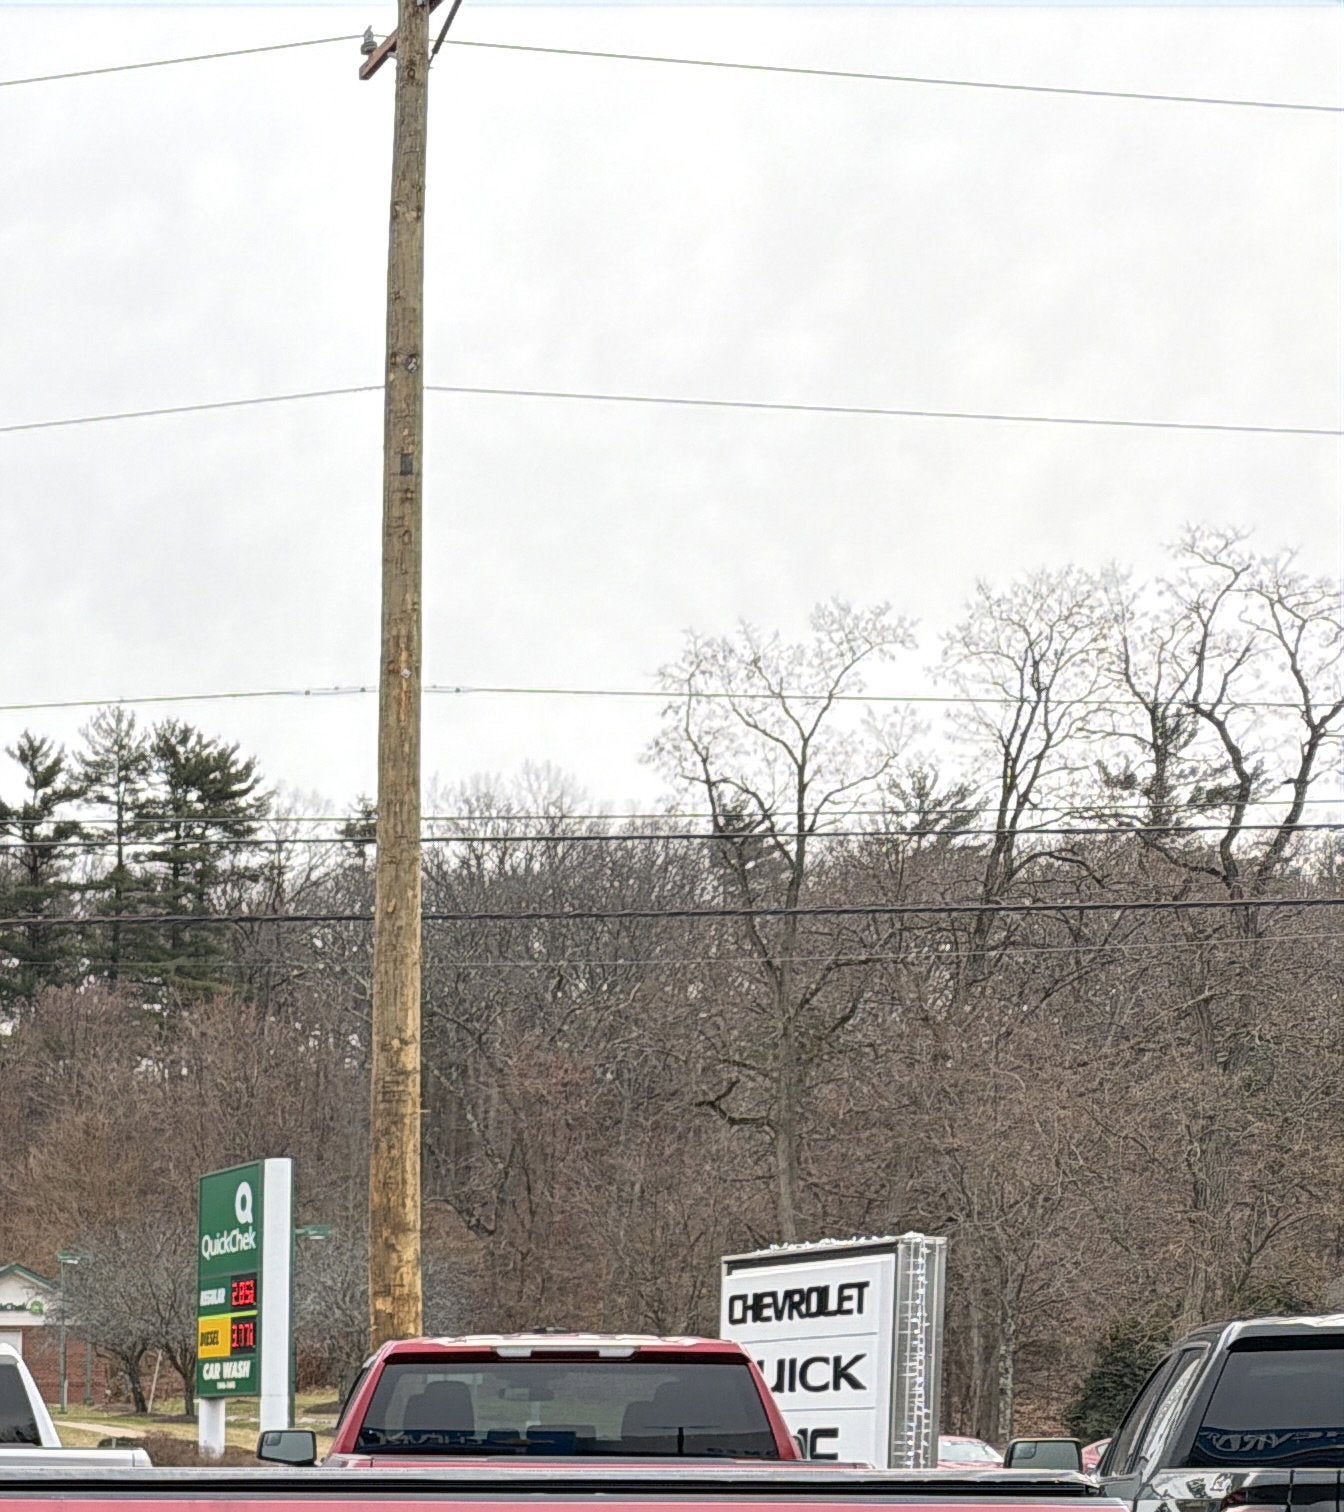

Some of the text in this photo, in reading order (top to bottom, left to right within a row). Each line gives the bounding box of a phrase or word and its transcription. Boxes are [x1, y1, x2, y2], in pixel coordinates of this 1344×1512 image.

[201, 1225, 256, 1261] QuickChek
[728, 1281, 870, 1325] CHEVROLET
[200, 1329, 220, 1346] DIESEL
[203, 1360, 251, 1380] CAR WASH
[758, 1353, 868, 1393] UICK
